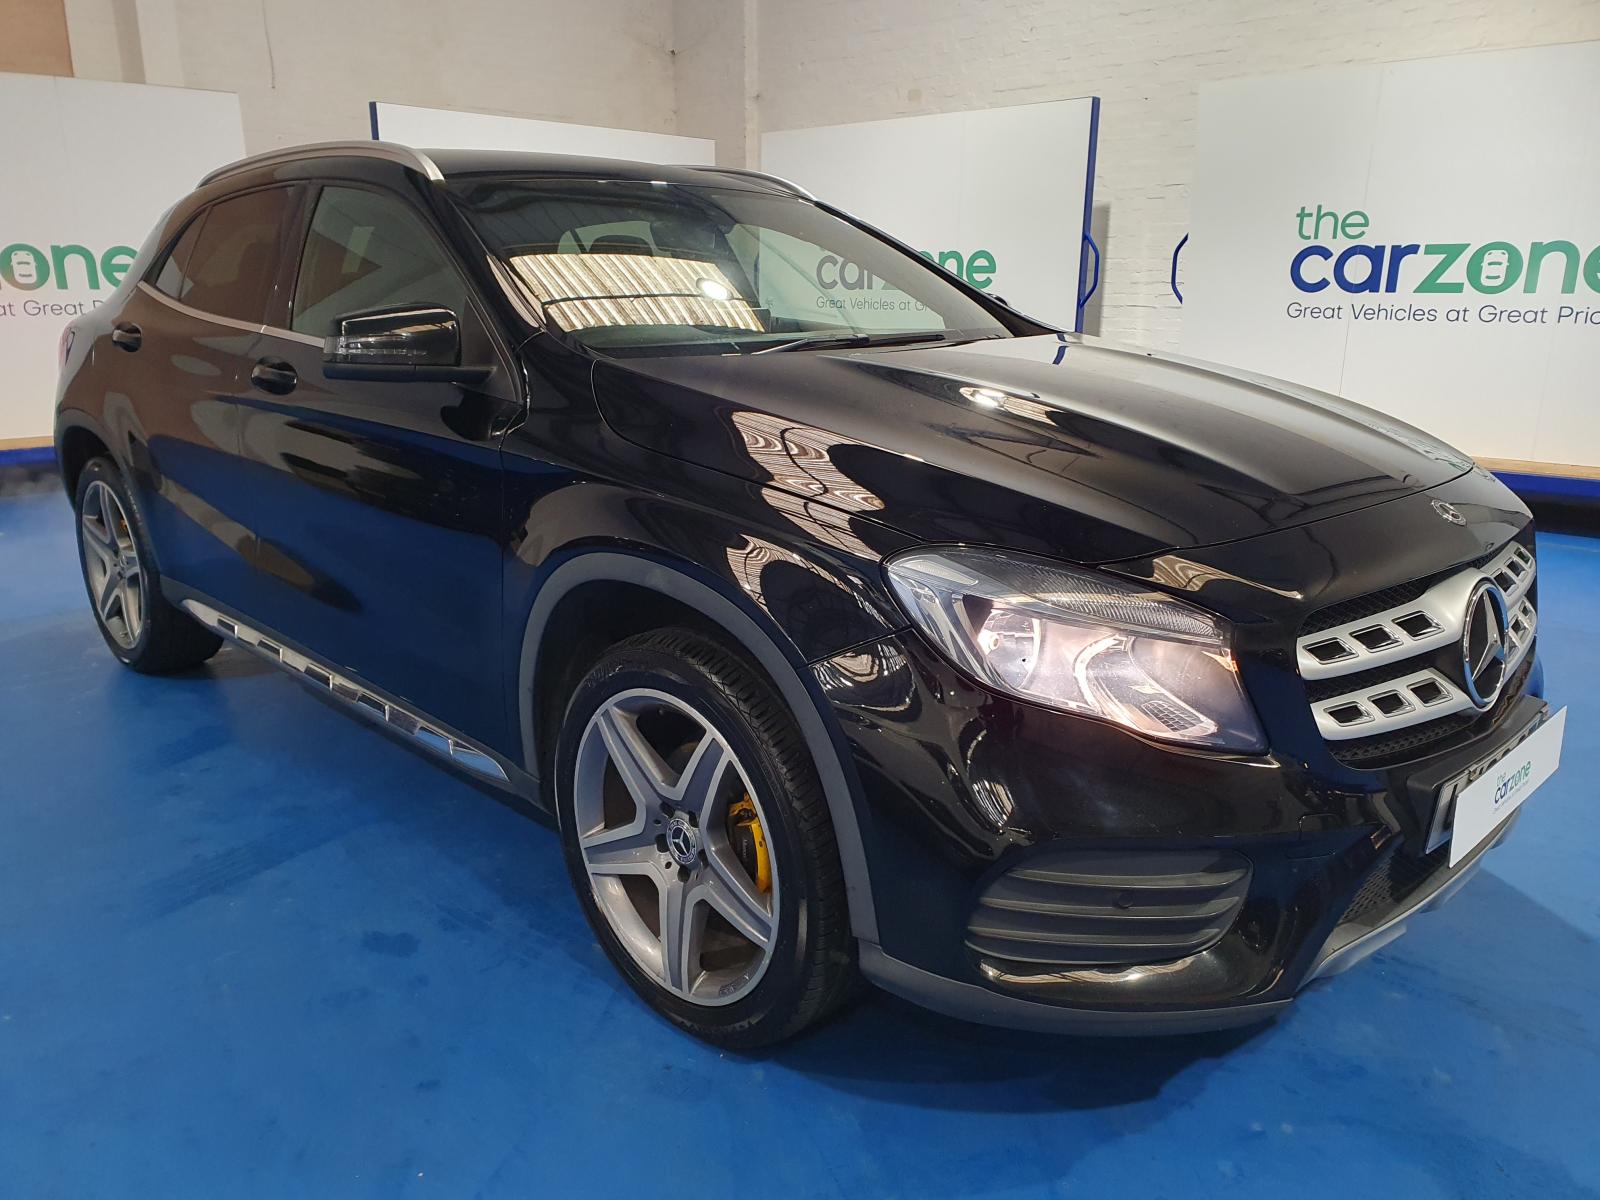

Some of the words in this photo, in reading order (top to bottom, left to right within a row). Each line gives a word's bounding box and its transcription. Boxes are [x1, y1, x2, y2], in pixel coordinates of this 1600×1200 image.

[1295, 204, 1370, 240] the
[0, 243, 138, 291] one
[23, 299, 86, 317] Great
[816, 295, 846, 309] Great
[850, 297, 895, 311] Vehicles
[898, 300, 911, 311] at
[1286, 301, 1343, 319] Great
[1351, 303, 1438, 322] Vehicles
[1446, 305, 1469, 322] at
[1478, 304, 1549, 324] Great
[1494, 760, 1532, 804] carzone
